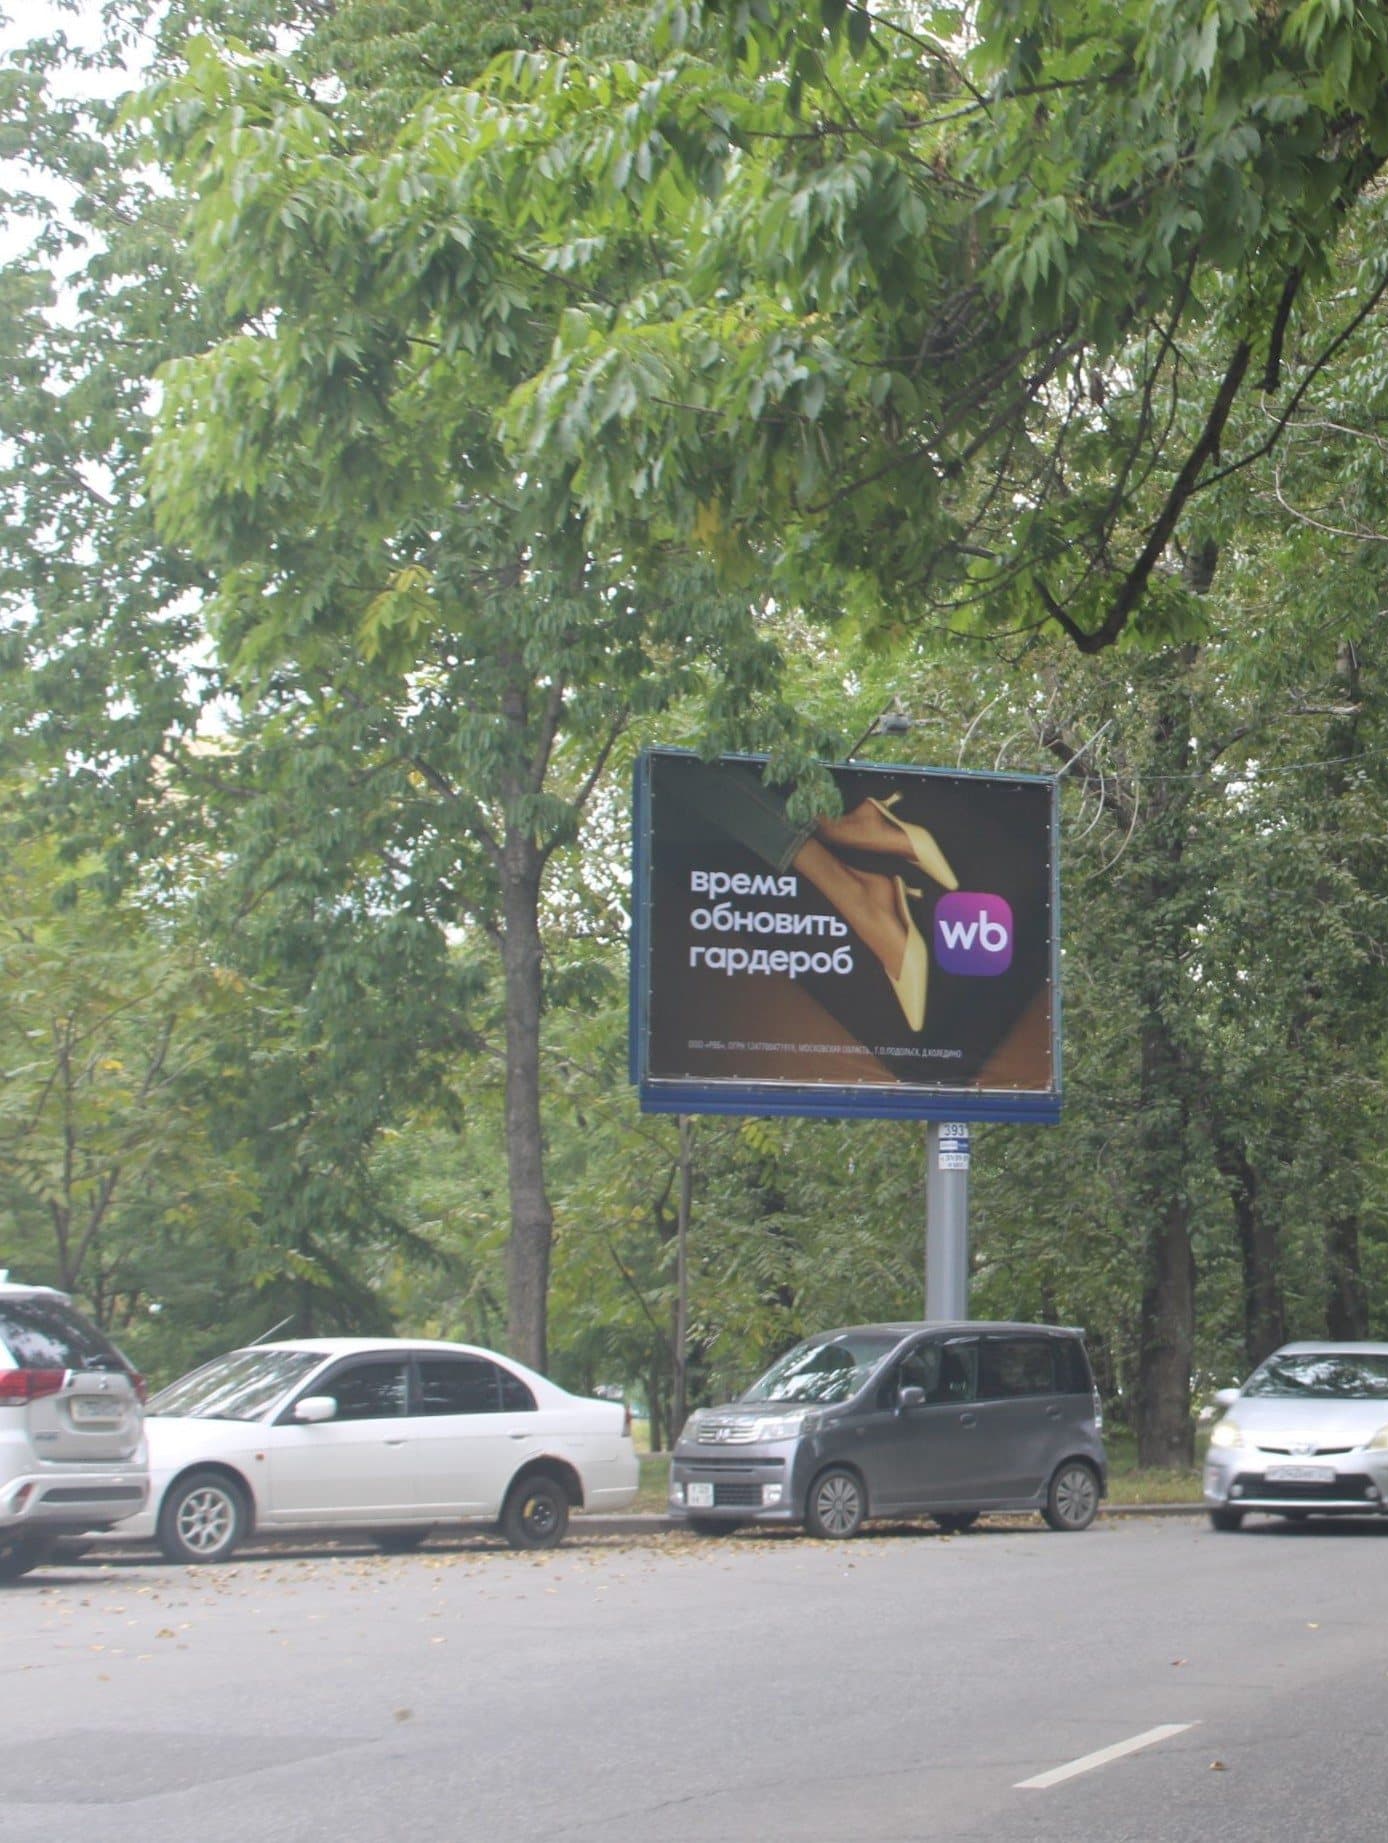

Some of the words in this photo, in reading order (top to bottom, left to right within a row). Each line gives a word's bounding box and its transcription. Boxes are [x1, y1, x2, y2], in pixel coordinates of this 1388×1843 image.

[690, 870, 797, 900] время
[690, 902, 848, 937] обновить
[939, 910, 1008, 952] wb
[689, 945, 854, 979] гардероб
[944, 1124, 965, 1136] 393
